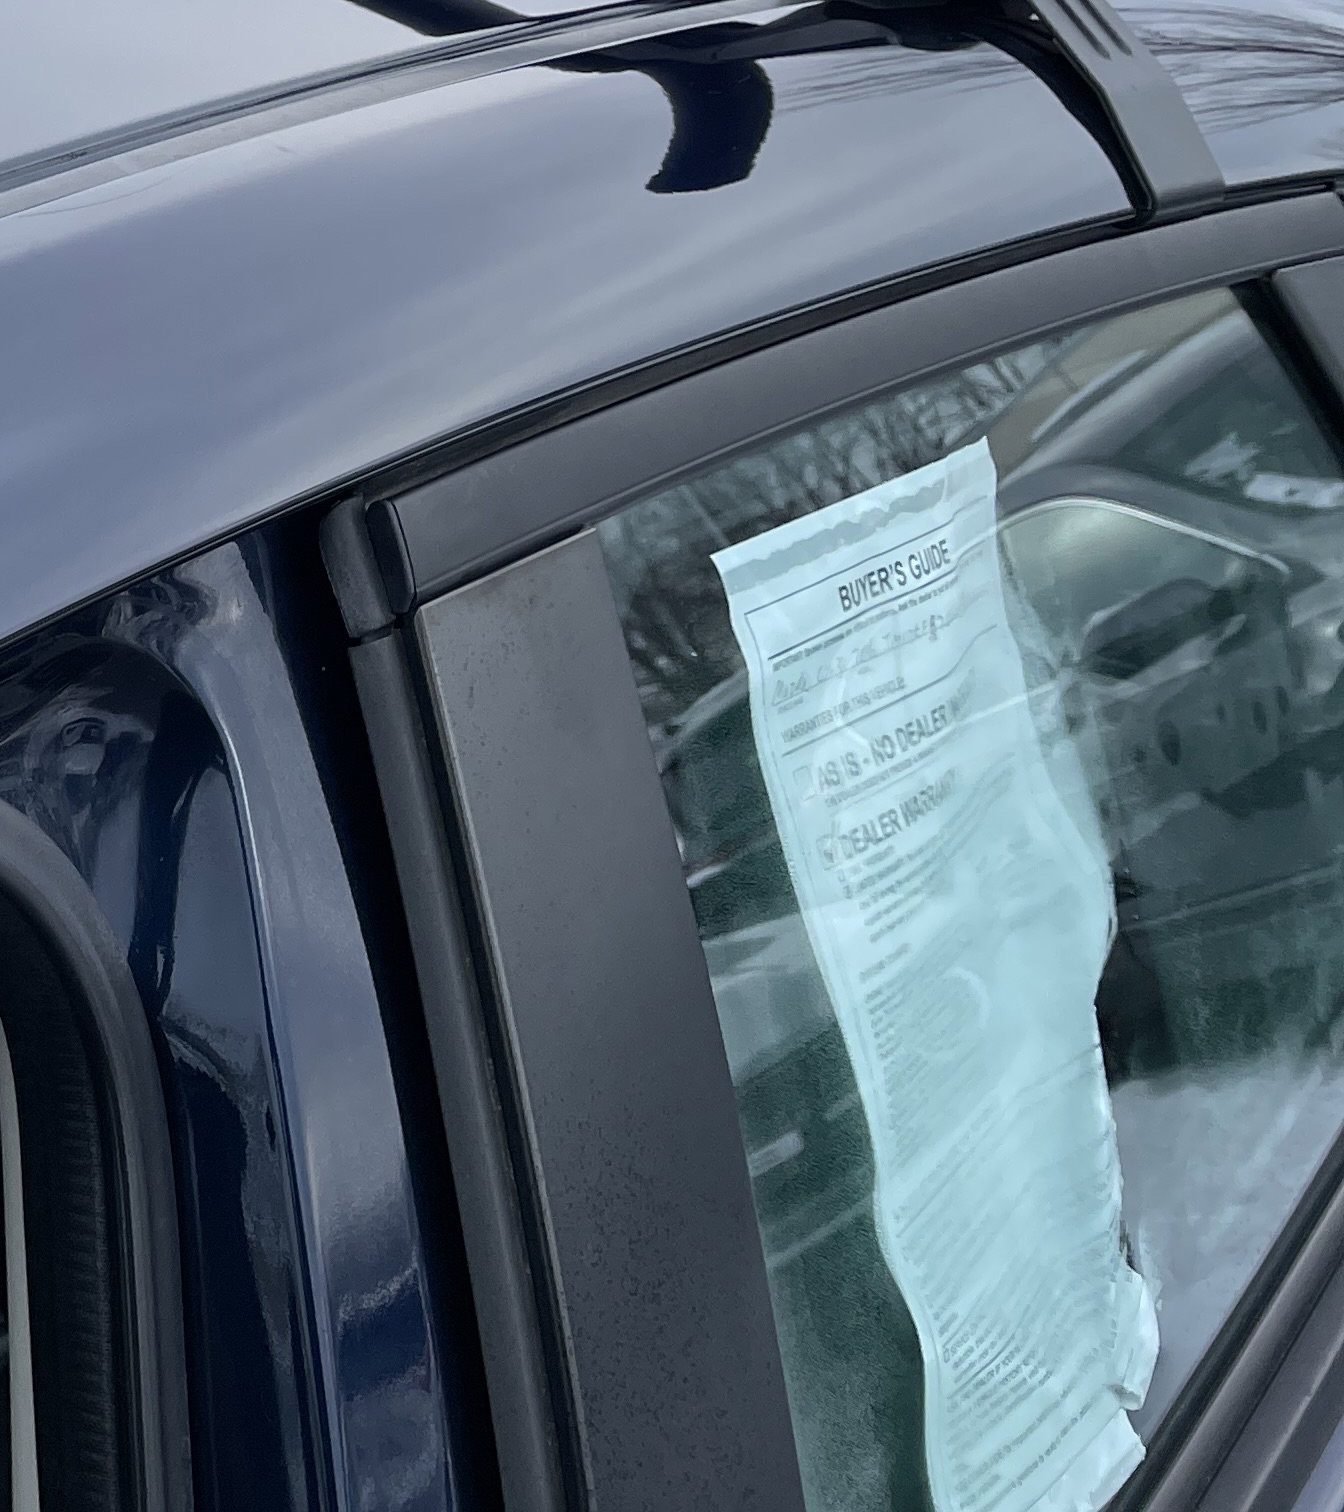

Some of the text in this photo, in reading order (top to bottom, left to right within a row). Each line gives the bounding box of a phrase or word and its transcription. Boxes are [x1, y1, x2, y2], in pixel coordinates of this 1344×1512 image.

[838, 538, 951, 613] BUYER'S GUIDE
[819, 761, 841, 790] AS
[841, 751, 862, 777] IS
[870, 734, 896, 767] NO
[895, 704, 947, 753] DEALER
[839, 808, 902, 859] DEALER
